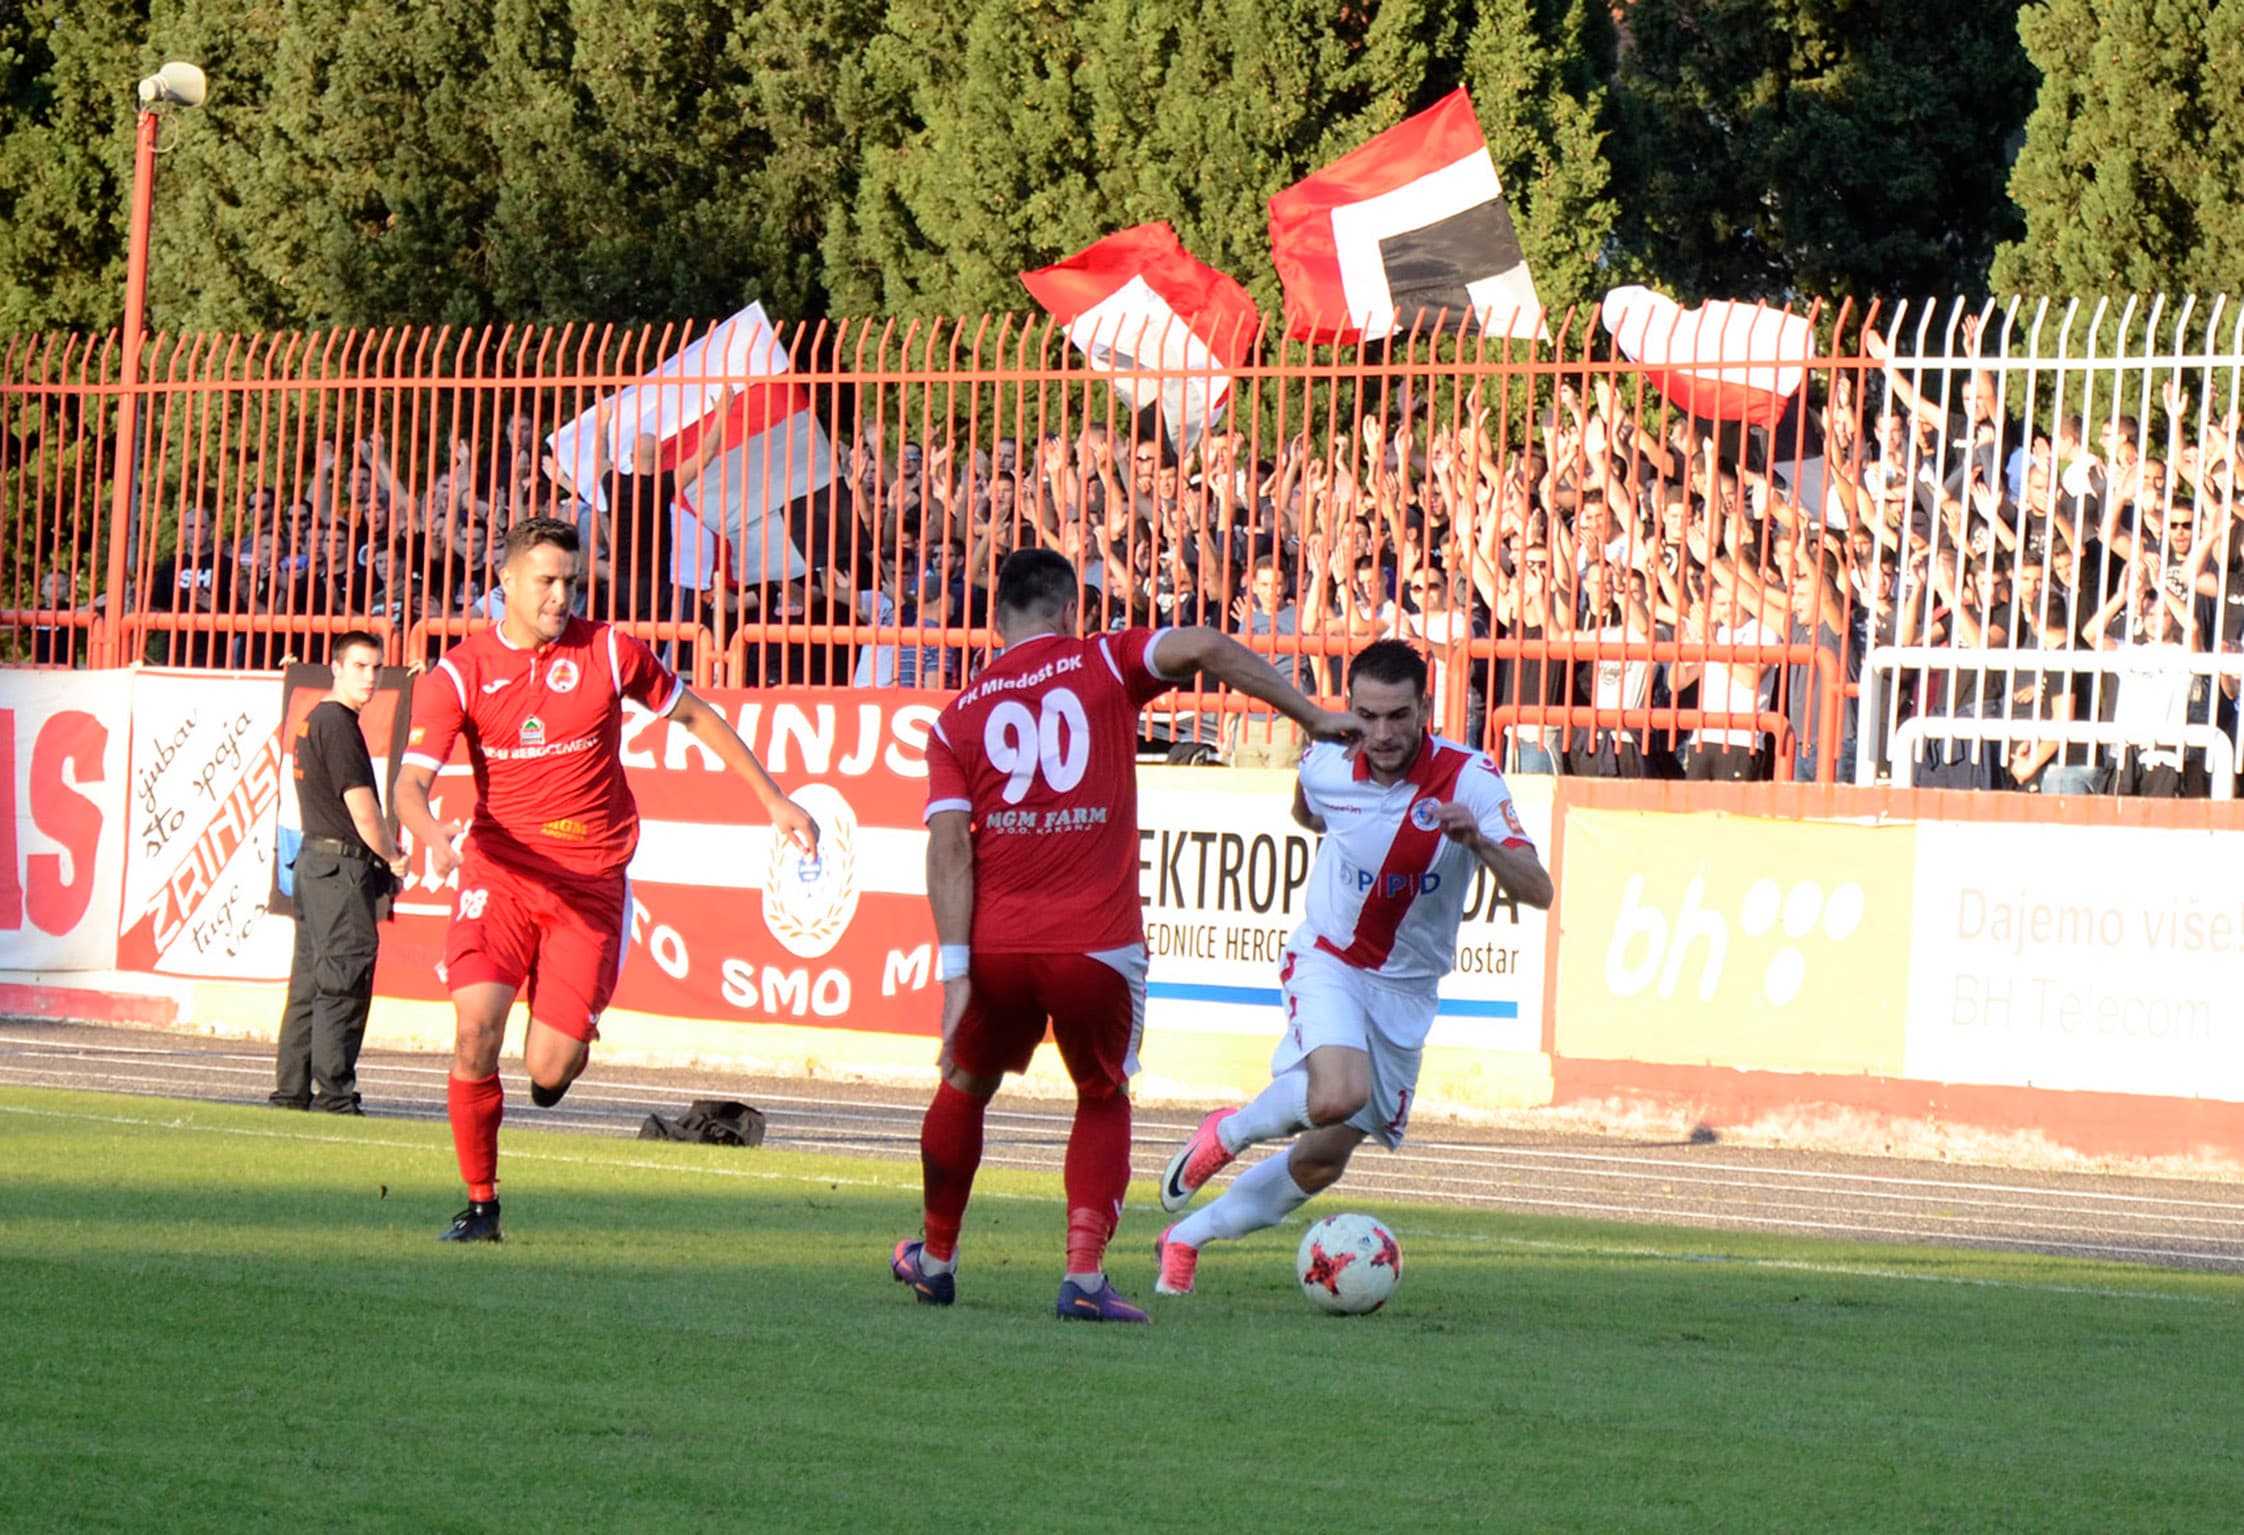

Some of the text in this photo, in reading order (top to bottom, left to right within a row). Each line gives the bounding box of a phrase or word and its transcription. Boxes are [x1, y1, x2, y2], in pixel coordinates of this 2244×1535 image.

[958, 654, 1083, 711] FK Mladost DK
[984, 687, 1090, 805] 90
[986, 807, 1108, 829] MGM FARM
[1605, 872, 1729, 999] bh
[1957, 886, 2126, 957] Dajemo
[721, 958, 852, 1016] SMO
[1951, 973, 2212, 1040] BH Telecom
